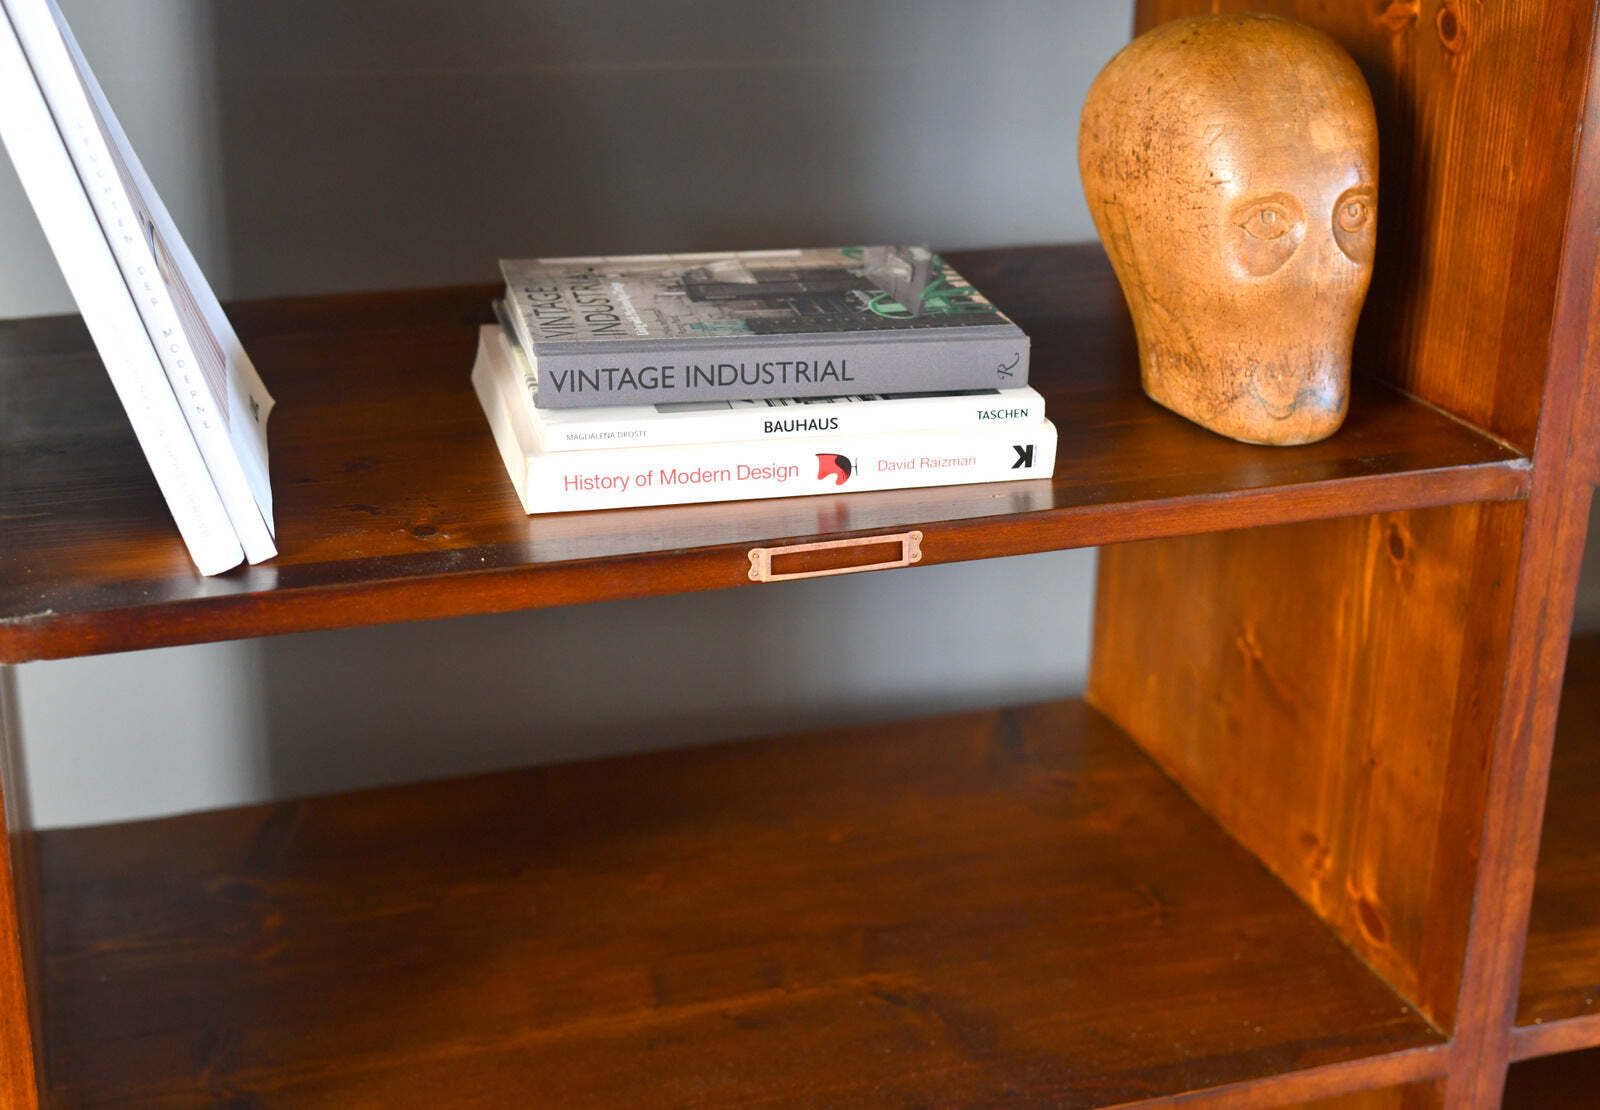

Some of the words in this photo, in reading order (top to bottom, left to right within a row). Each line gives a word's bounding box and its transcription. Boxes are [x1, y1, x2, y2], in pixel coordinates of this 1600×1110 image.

[525, 285, 577, 339] VINTAGE
[549, 365, 676, 393] VINTAGE
[685, 359, 854, 386] INDUSTRIAL
[976, 407, 1029, 421] TASCHEN
[763, 416, 839, 434] BAUHAUS
[566, 431, 616, 441] MAGDALENA
[877, 457, 916, 472] David
[919, 455, 977, 470] Raizman
[564, 472, 630, 493] History
[635, 470, 655, 487] of
[659, 465, 731, 485] Modern
[736, 461, 799, 482] Design
